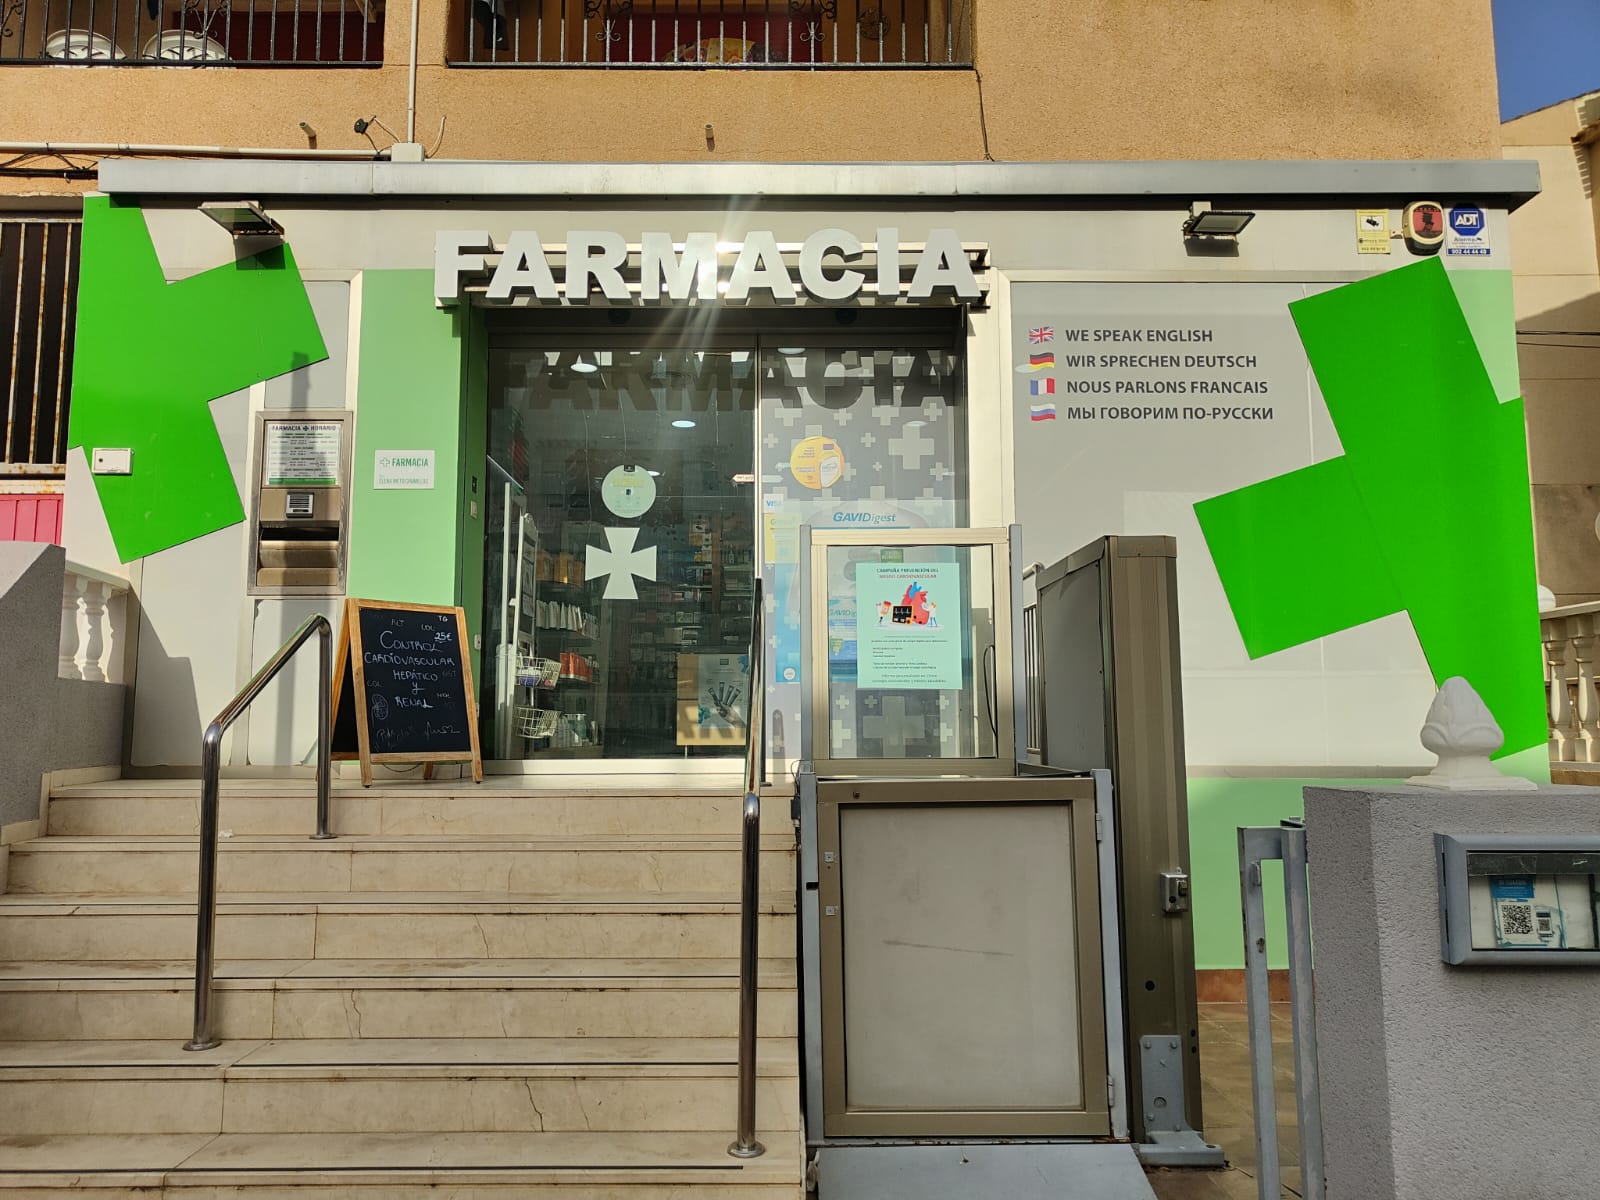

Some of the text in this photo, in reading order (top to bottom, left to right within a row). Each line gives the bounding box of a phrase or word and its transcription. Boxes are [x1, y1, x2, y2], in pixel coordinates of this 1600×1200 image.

[1455, 213, 1479, 226] ADT
[434, 227, 981, 302] FARMACIA
[1065, 329, 1213, 342] WE SPEAK ENGLISH
[1066, 355, 1257, 368] WIR SPRECHEN DEUTSCH
[1067, 381, 1268, 394] NOUS PARLONS FRANCAIS
[1067, 407, 1274, 420] МЫ ГОВОРИМ ПО-РУССКИ
[391, 457, 429, 467] FARMACIA
[832, 511, 897, 524] GAVIDigest
[434, 632, 453, 642] 25€
[393, 669, 438, 681] HEPÁTICO
[394, 696, 433, 708] RENAL
